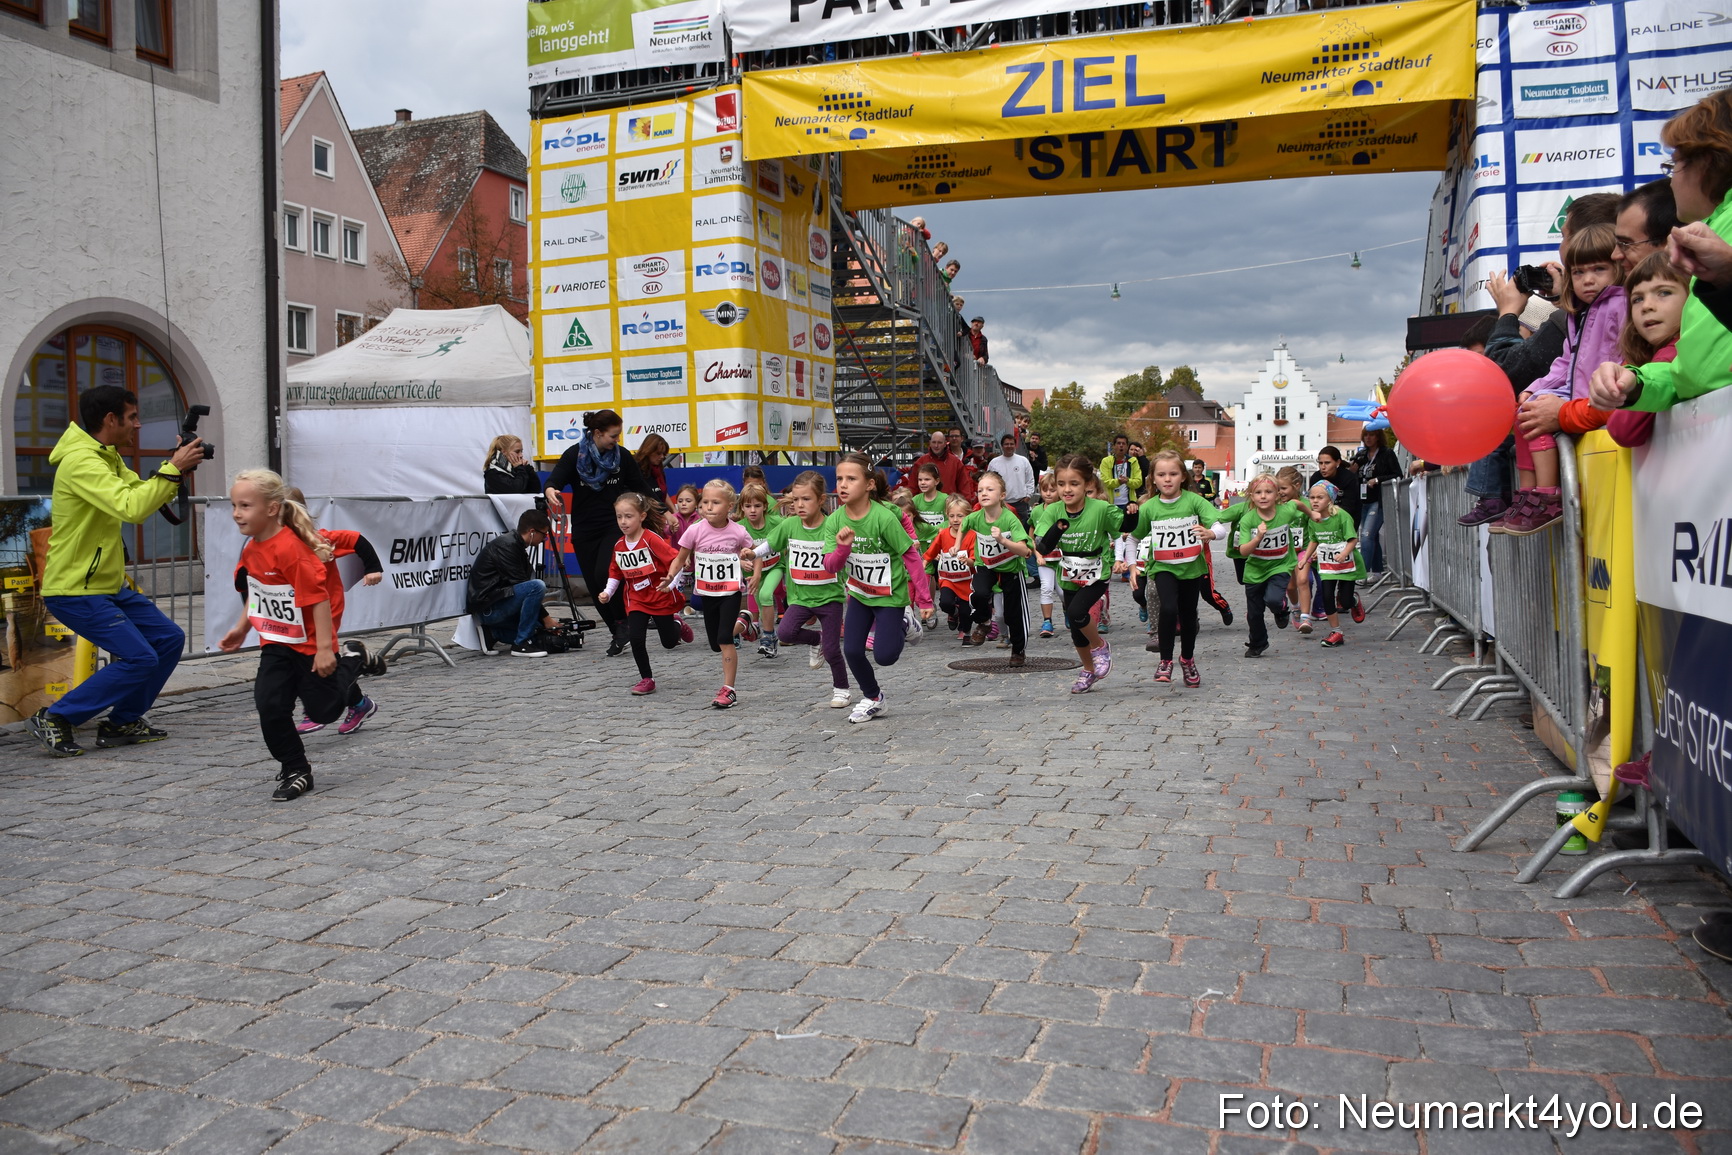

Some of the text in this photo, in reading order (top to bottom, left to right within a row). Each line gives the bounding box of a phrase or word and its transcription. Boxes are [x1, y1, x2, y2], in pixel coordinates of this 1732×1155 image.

[551, 20, 575, 32] wo's
[1533, 17, 1576, 26] GERHART
[1631, 20, 1703, 36] RAIL.ONE
[540, 28, 610, 53] langgeht!
[649, 31, 713, 47] NeuerMarkt
[1552, 44, 1573, 53] KIA
[1261, 54, 1433, 84] Neumarkter Stadtlauf
[1002, 54, 1165, 118] ZIEL
[1637, 70, 1732, 94] NATHUS
[1524, 84, 1604, 98] Neumarkter Tagblatt
[775, 104, 914, 127] Neumarkter Stadtlauf
[654, 129, 673, 137] KANN
[576, 141, 605, 153] energie
[1277, 133, 1417, 154] Neumarkter Stadtlauf
[1028, 121, 1238, 180] START
[1546, 147, 1616, 162] VARIOTEC
[619, 167, 660, 186] swn
[872, 166, 992, 183] Neumarkter Stadtlauf
[618, 180, 671, 192] stadtwerke neumarkt
[696, 215, 742, 227] RAIL.ONE
[544, 236, 588, 247] RAIL.ONE
[633, 261, 661, 269] GERHART
[561, 280, 606, 293] VARIOTEC
[717, 310, 735, 318] MINI
[655, 329, 683, 340] energie
[629, 369, 680, 380] Neumarkter Tagblatt
[547, 383, 592, 395] RAIL.ONE
[644, 422, 687, 434] VARIOTEC
[1281, 453, 1314, 462] Laufsport
[1168, 522, 1191, 530] Neumarkt
[1156, 529, 1197, 548] 7215
[390, 536, 437, 564] BMW
[699, 563, 734, 580] 7181
[847, 561, 885, 583] 7077
[705, 583, 728, 591] Madlen
[254, 592, 295, 621] 7185
[261, 621, 288, 634] Hannah
